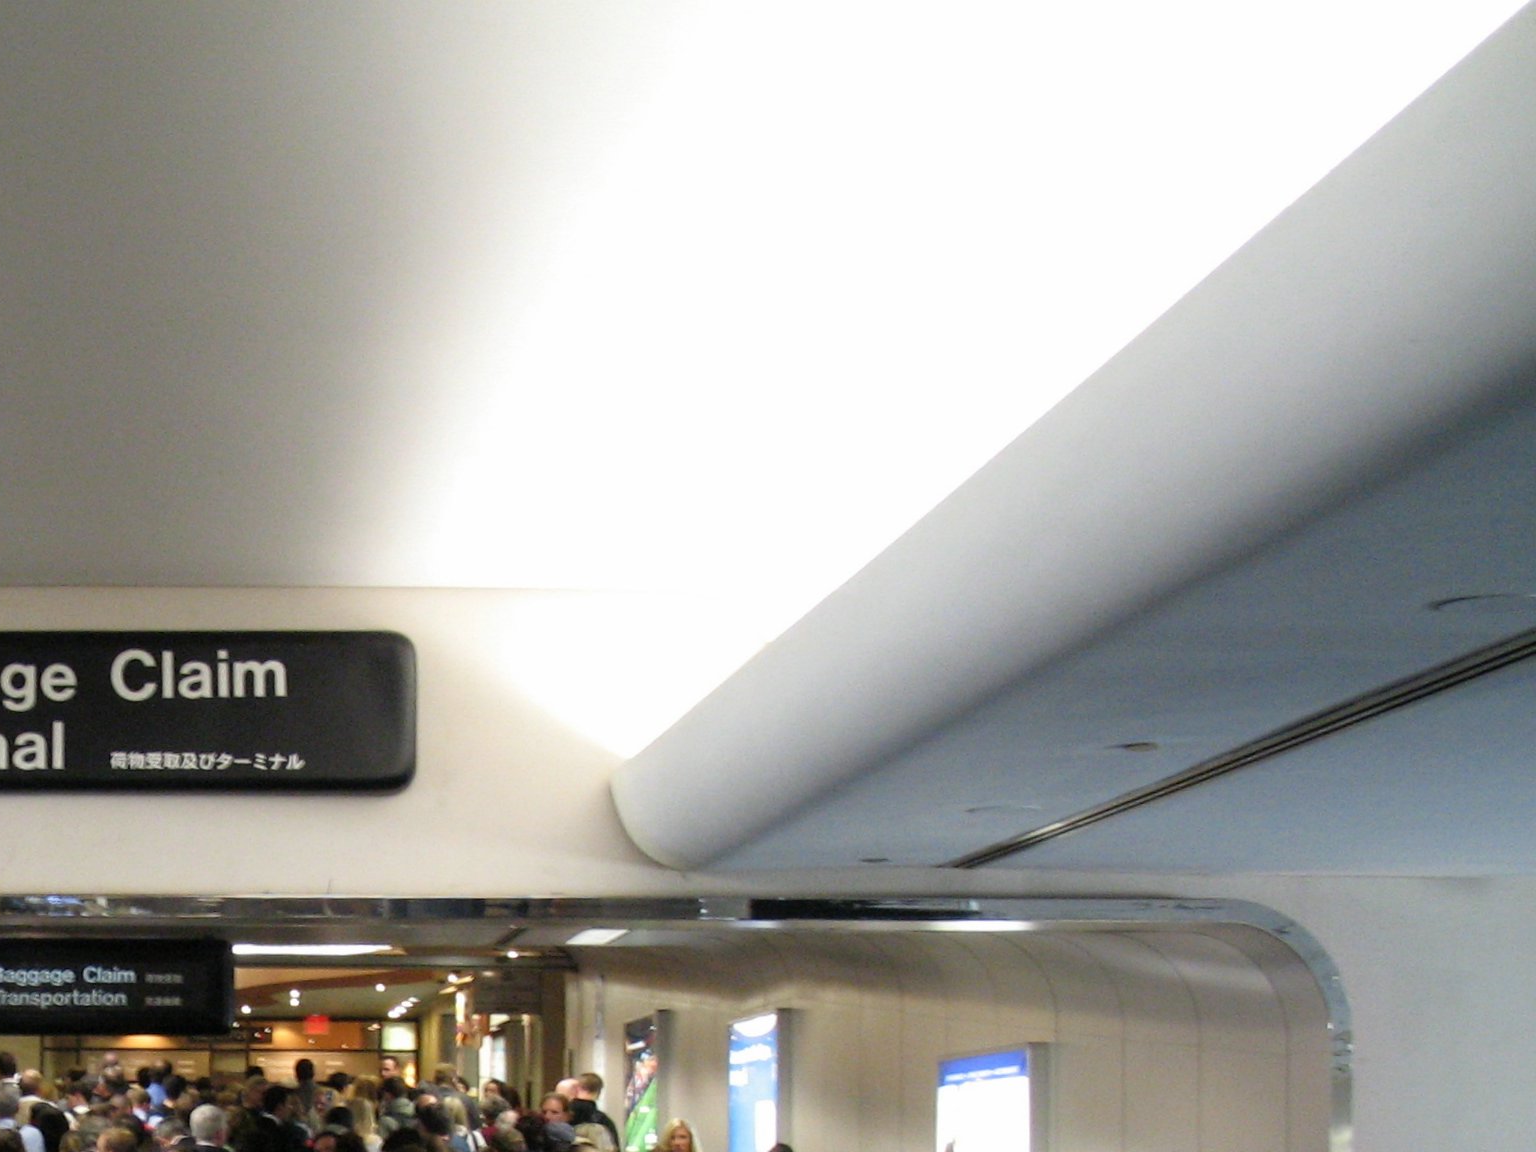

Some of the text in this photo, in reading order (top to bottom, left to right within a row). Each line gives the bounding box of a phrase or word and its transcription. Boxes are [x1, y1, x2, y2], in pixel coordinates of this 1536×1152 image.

[110, 649, 287, 702] Claim
[110, 751, 306, 771] 荷物受取及びターミナル
[82, 964, 137, 984] Claim
